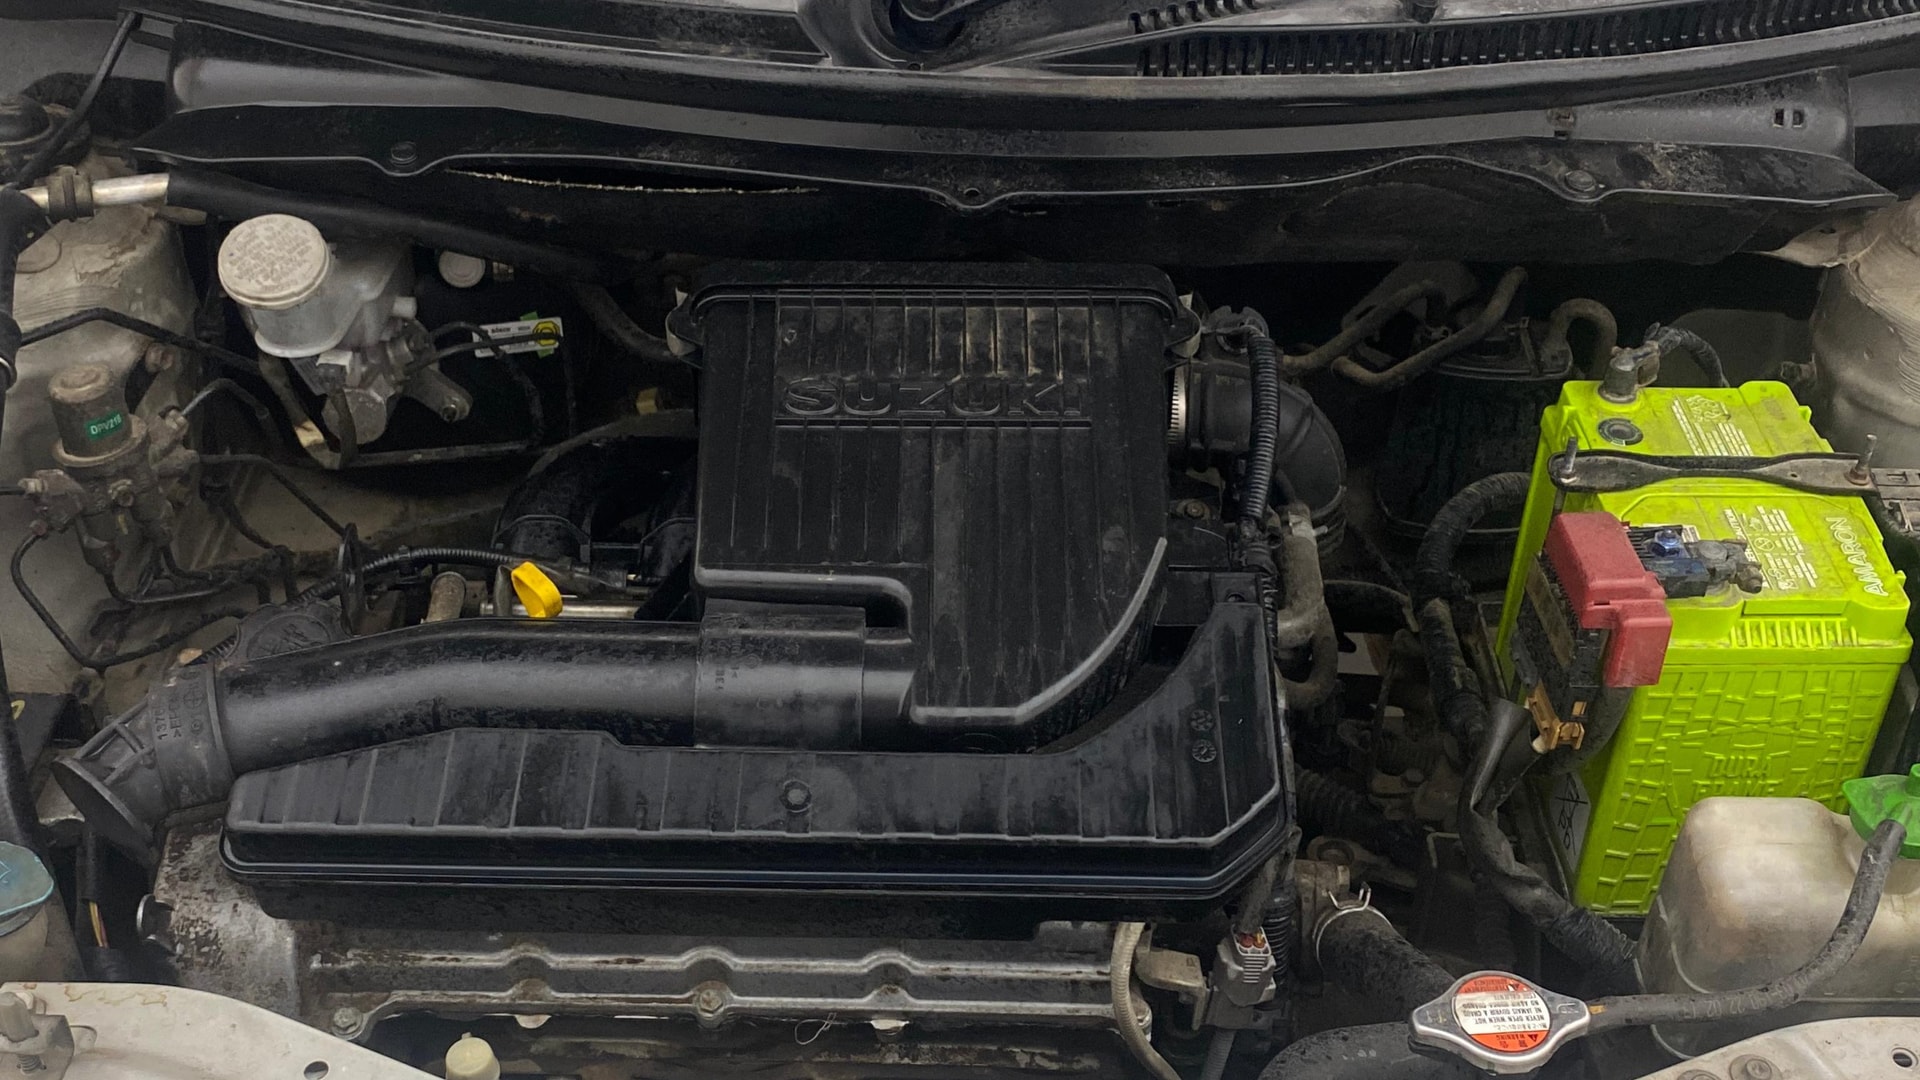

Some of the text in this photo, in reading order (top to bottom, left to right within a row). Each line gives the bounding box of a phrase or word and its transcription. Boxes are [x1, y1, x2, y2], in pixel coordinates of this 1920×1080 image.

[784, 376, 1082, 416] SUZUKI
[1825, 516, 1889, 597] AMARON
[1708, 755, 1774, 779] DURA
